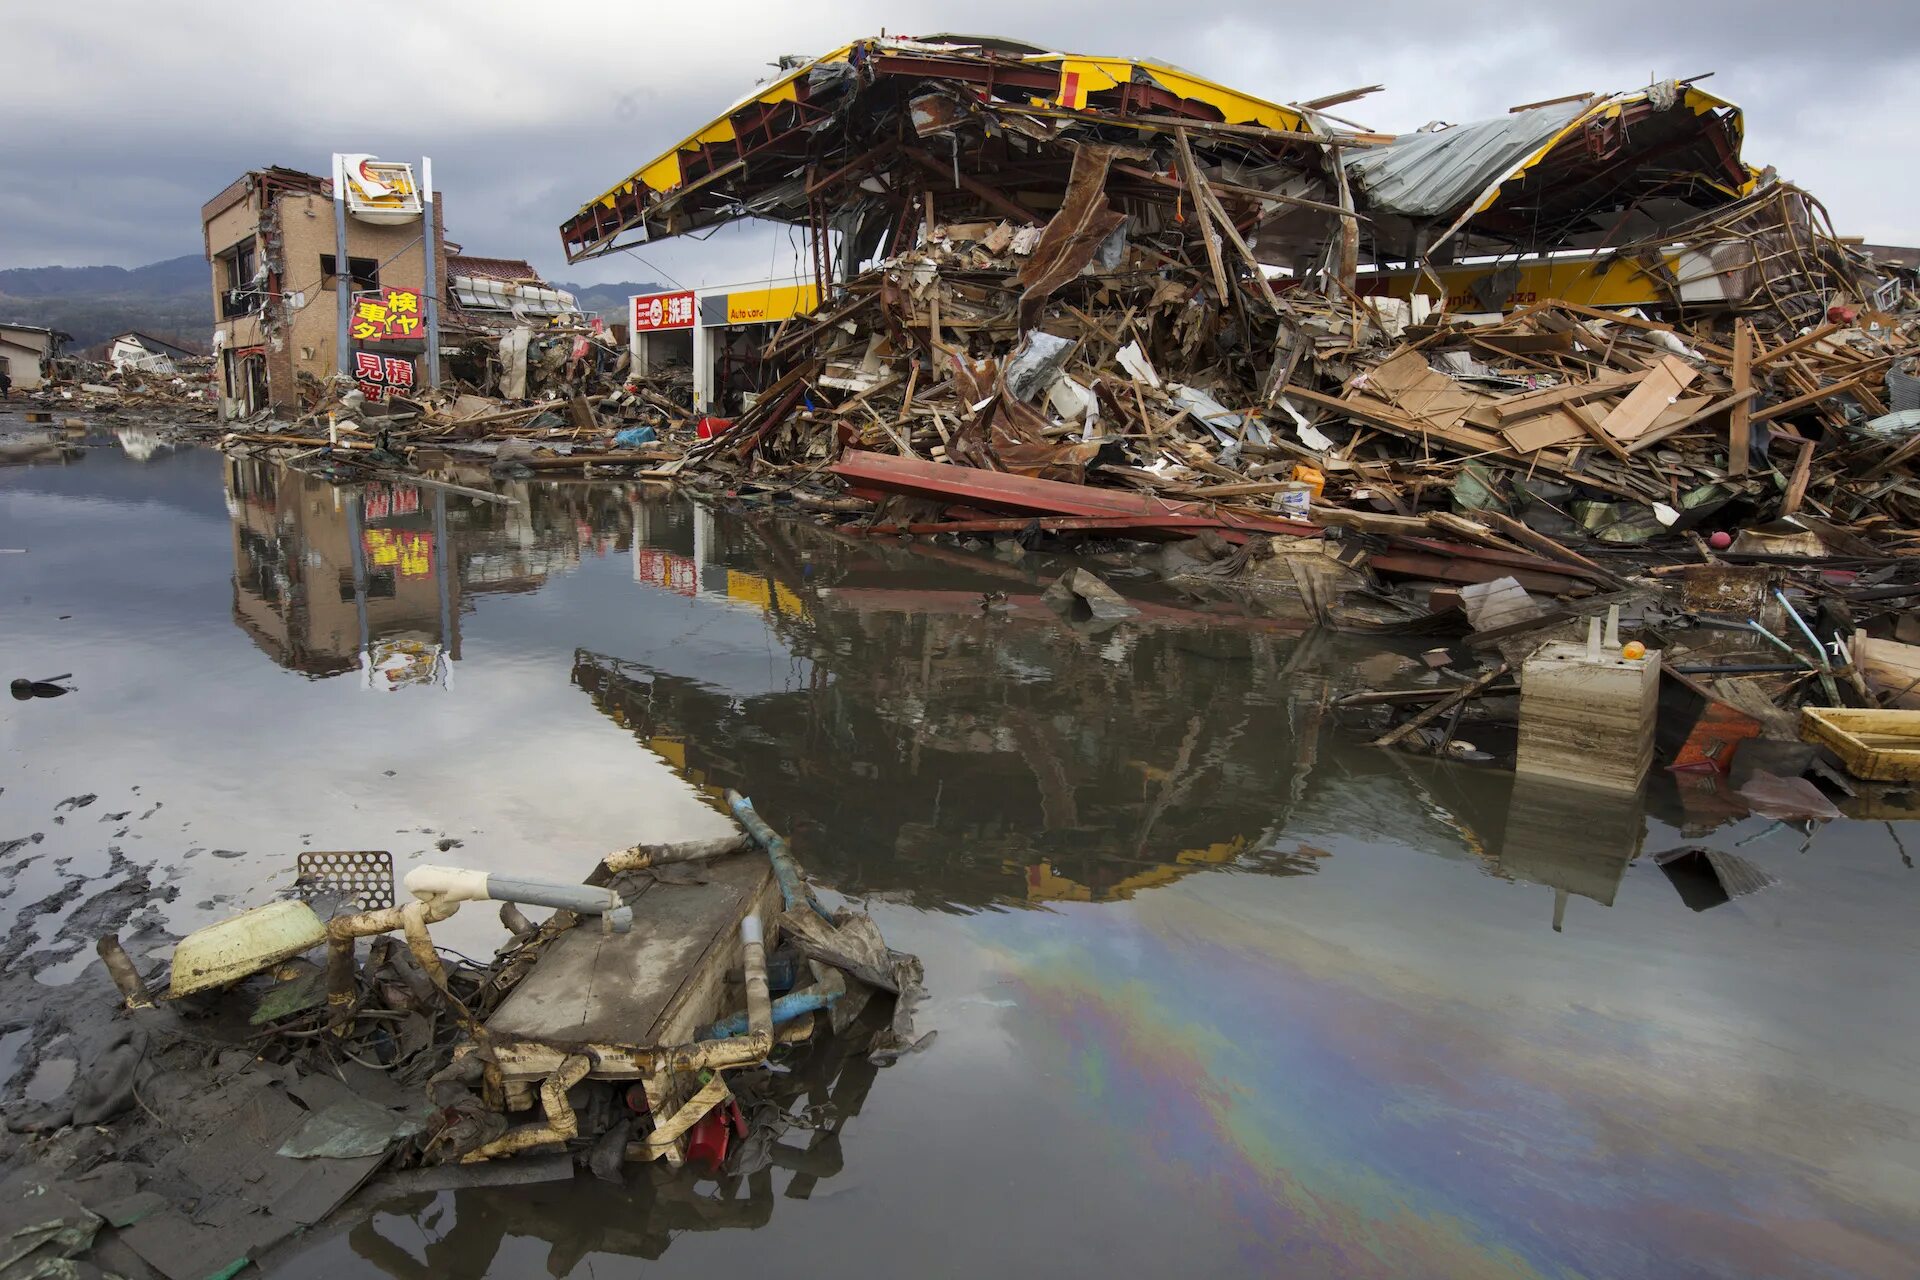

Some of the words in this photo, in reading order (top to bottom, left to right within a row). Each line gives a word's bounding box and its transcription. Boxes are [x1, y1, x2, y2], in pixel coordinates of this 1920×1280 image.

[669, 296, 692, 324] 洗車
[730, 309, 747, 319] Auto
[356, 351, 413, 387] 見積
